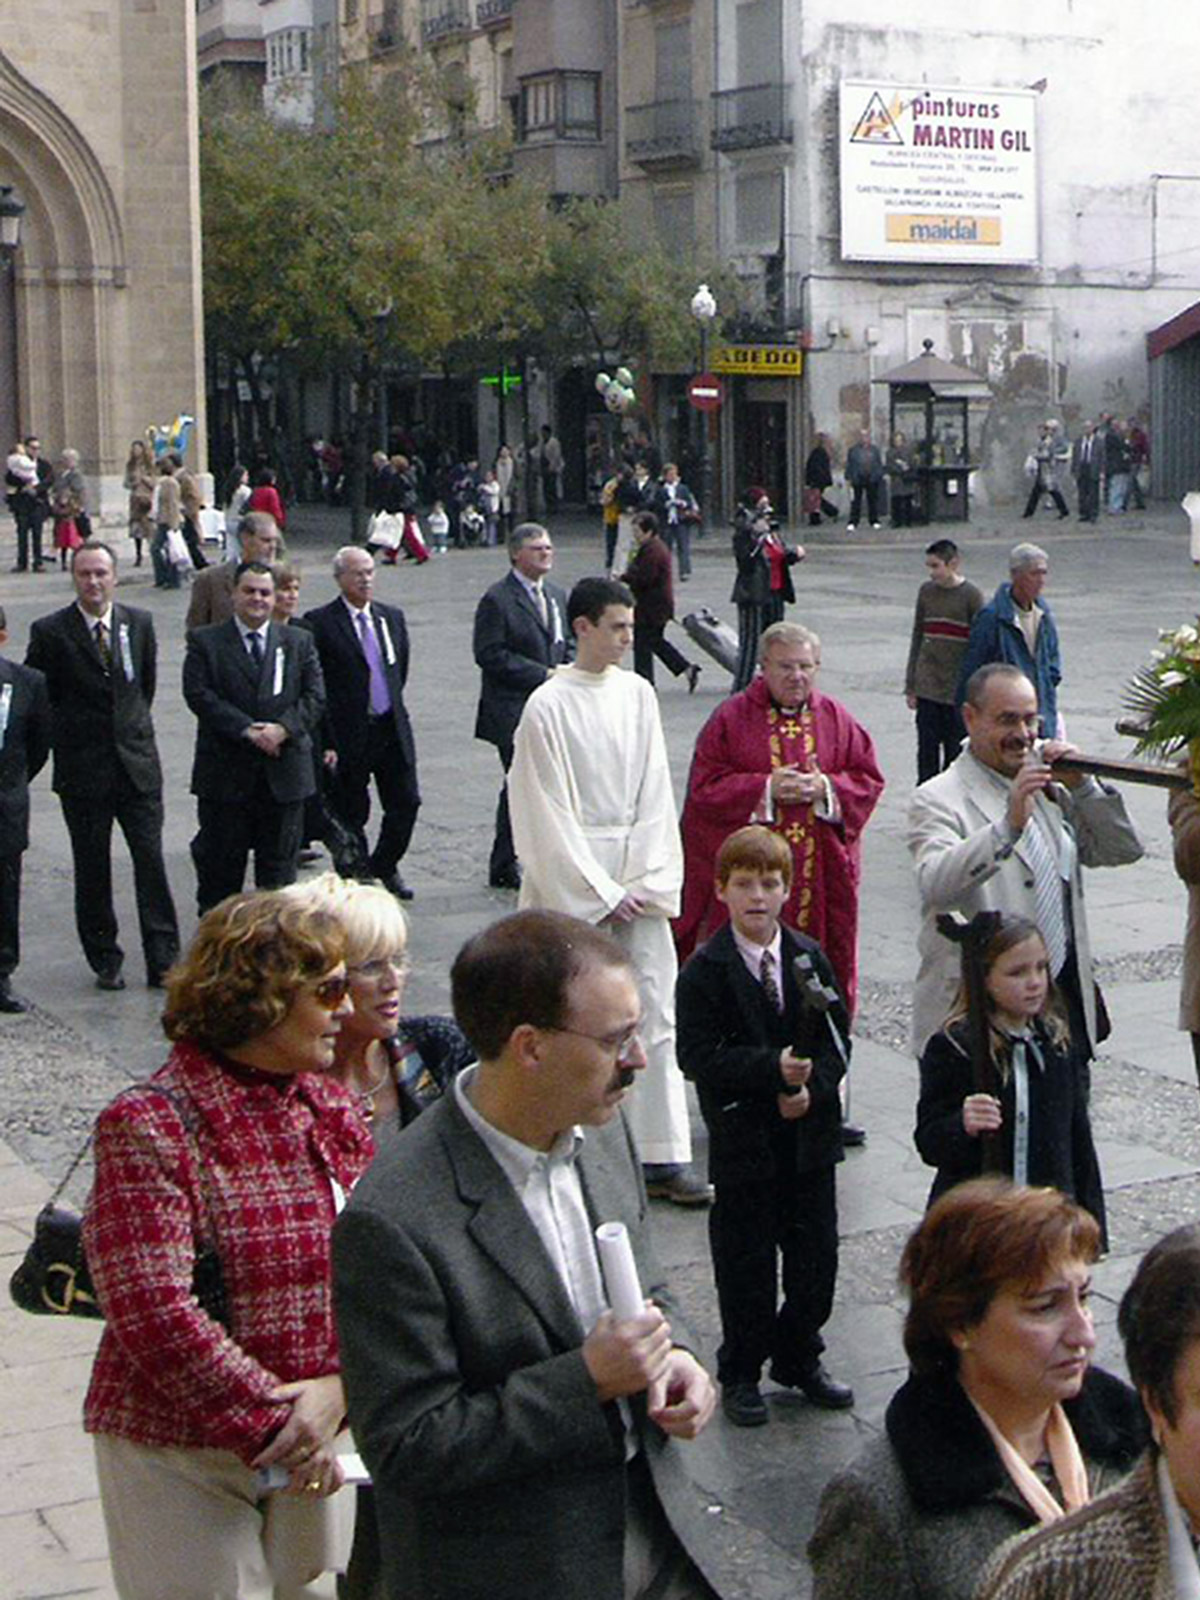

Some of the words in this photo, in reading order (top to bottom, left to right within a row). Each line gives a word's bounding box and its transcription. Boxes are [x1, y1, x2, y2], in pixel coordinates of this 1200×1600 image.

[911, 92, 1000, 120] pinturas
[912, 125, 995, 150] MARTIN
[1001, 130, 1031, 152] GIL
[910, 219, 977, 240] maidal
